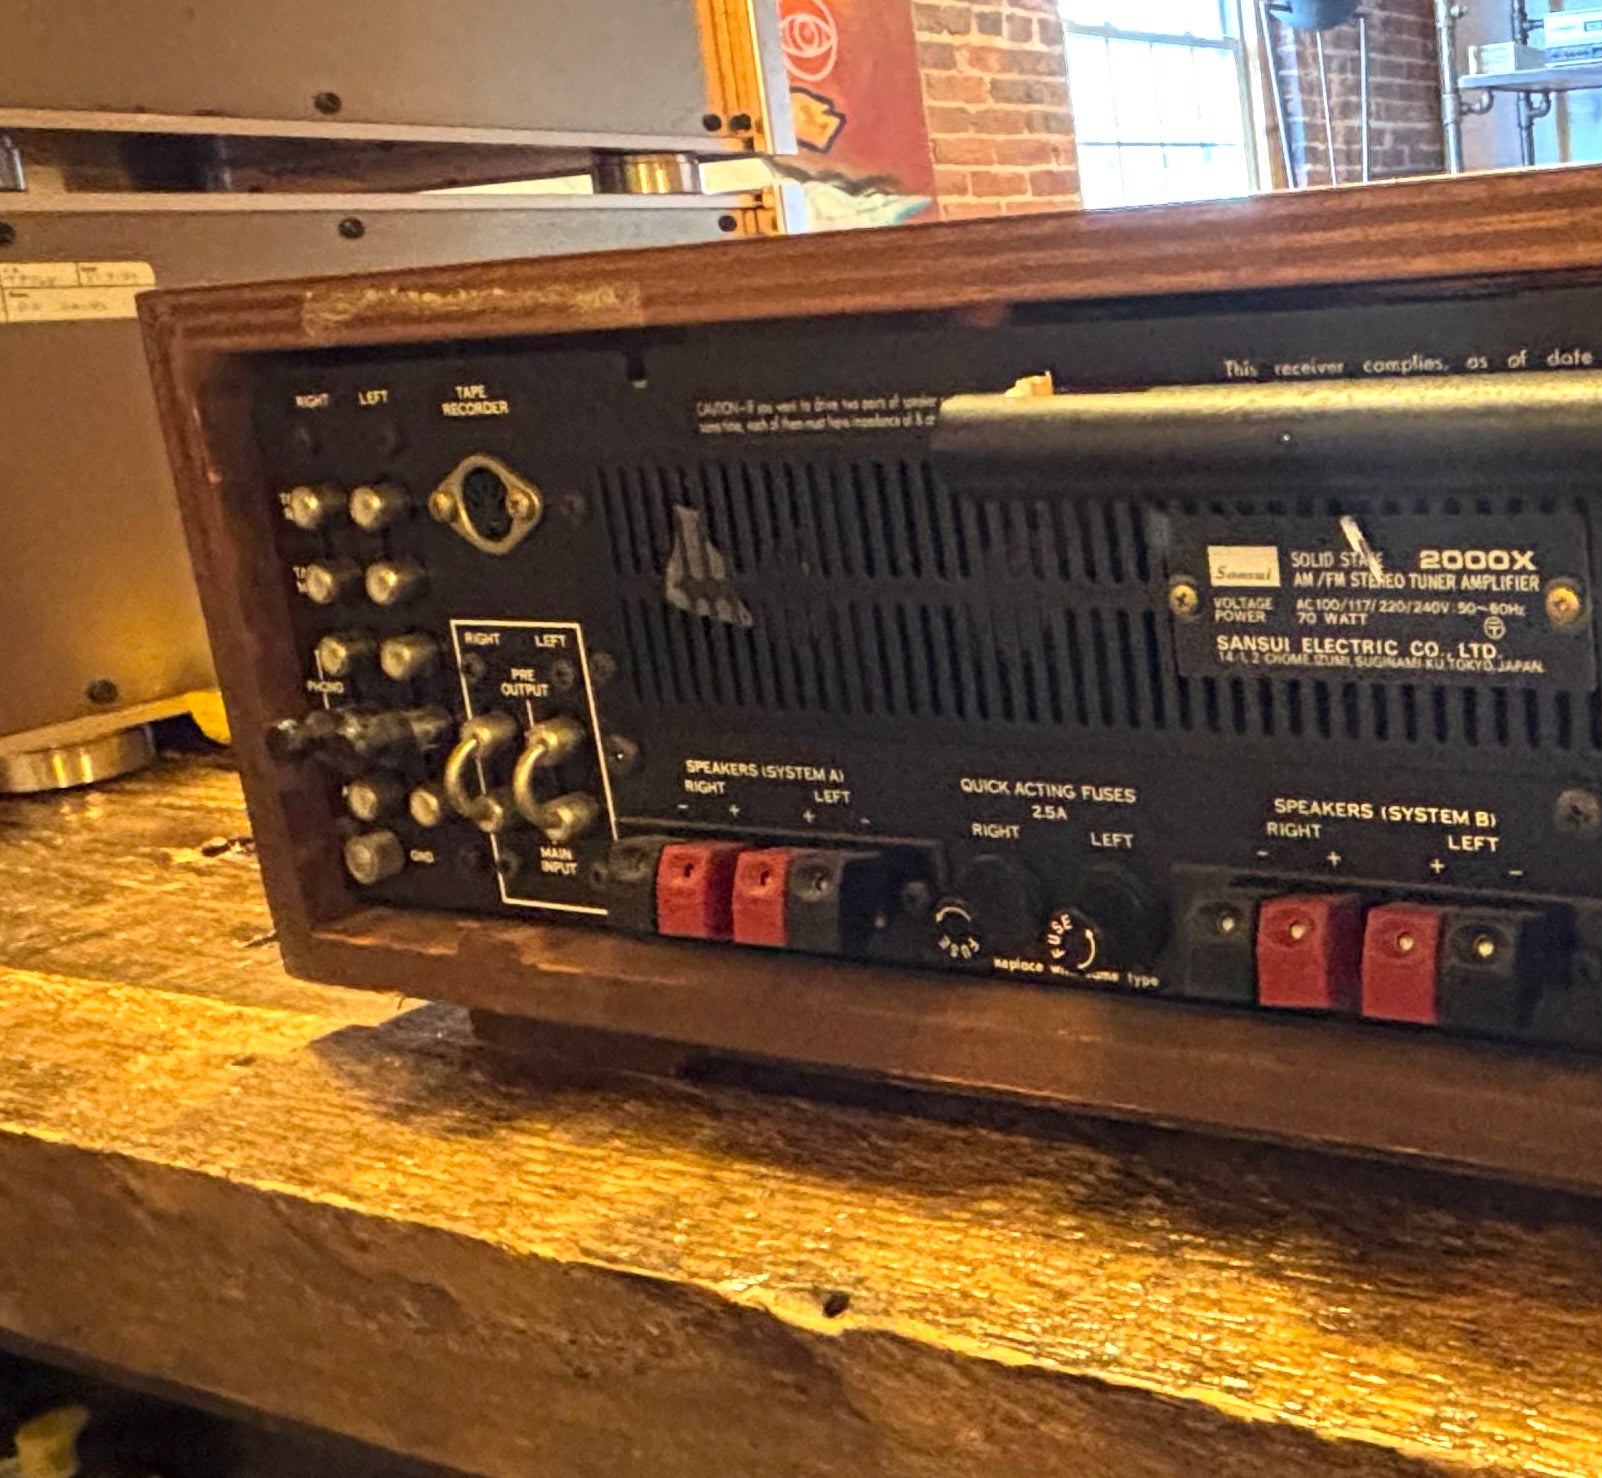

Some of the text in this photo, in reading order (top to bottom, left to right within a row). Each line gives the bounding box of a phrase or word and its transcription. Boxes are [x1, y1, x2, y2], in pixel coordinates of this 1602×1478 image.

[1224, 359, 1258, 377] This
[1274, 357, 1345, 376] receiver
[1362, 353, 1449, 375] complies,
[1466, 355, 1489, 369] as
[1507, 350, 1527, 368] of
[1547, 348, 1592, 366] date
[358, 390, 389, 406] LEFT
[455, 384, 487, 399] TAPE
[295, 393, 329, 408] RIGHT
[441, 400, 508, 416] RECORDER
[1290, 551, 1335, 568] SOLID
[1419, 549, 1538, 571] 2000X
[1215, 565, 1273, 581] Sansui
[1408, 573, 1456, 591] TUNER
[1460, 573, 1540, 592] AMPLIFIER
[1212, 597, 1274, 611] VOLTAGE
[1214, 610, 1369, 626] POWER 70 WATT
[463, 631, 500, 646] RIGHT
[534, 633, 566, 648] LEFT
[1216, 634, 1291, 653] SANSUI
[1301, 636, 1399, 657] ELECTRIC
[1458, 641, 1504, 661] LTD.
[510, 668, 536, 681] PRE
[501, 682, 549, 697] OUTPUT
[685, 760, 845, 783] SPEAKERS (SYSTEM A)
[684, 780, 726, 795] RIGHT
[960, 778, 1136, 803] QUICK ACTING FUSES
[814, 790, 850, 804] LEFT
[1274, 798, 1498, 828] SPEAKERS (SYSTEM B)
[971, 823, 1020, 839] RIGHT
[1266, 821, 1322, 839] RIGHT
[1090, 832, 1134, 848] LEFT
[1448, 835, 1499, 853] LEFT
[540, 847, 572, 861] MAIN
[541, 859, 578, 876] INPUT
[1048, 913, 1073, 959] FUSE
[994, 956, 1045, 974] Replace
[1126, 970, 1160, 989] type
